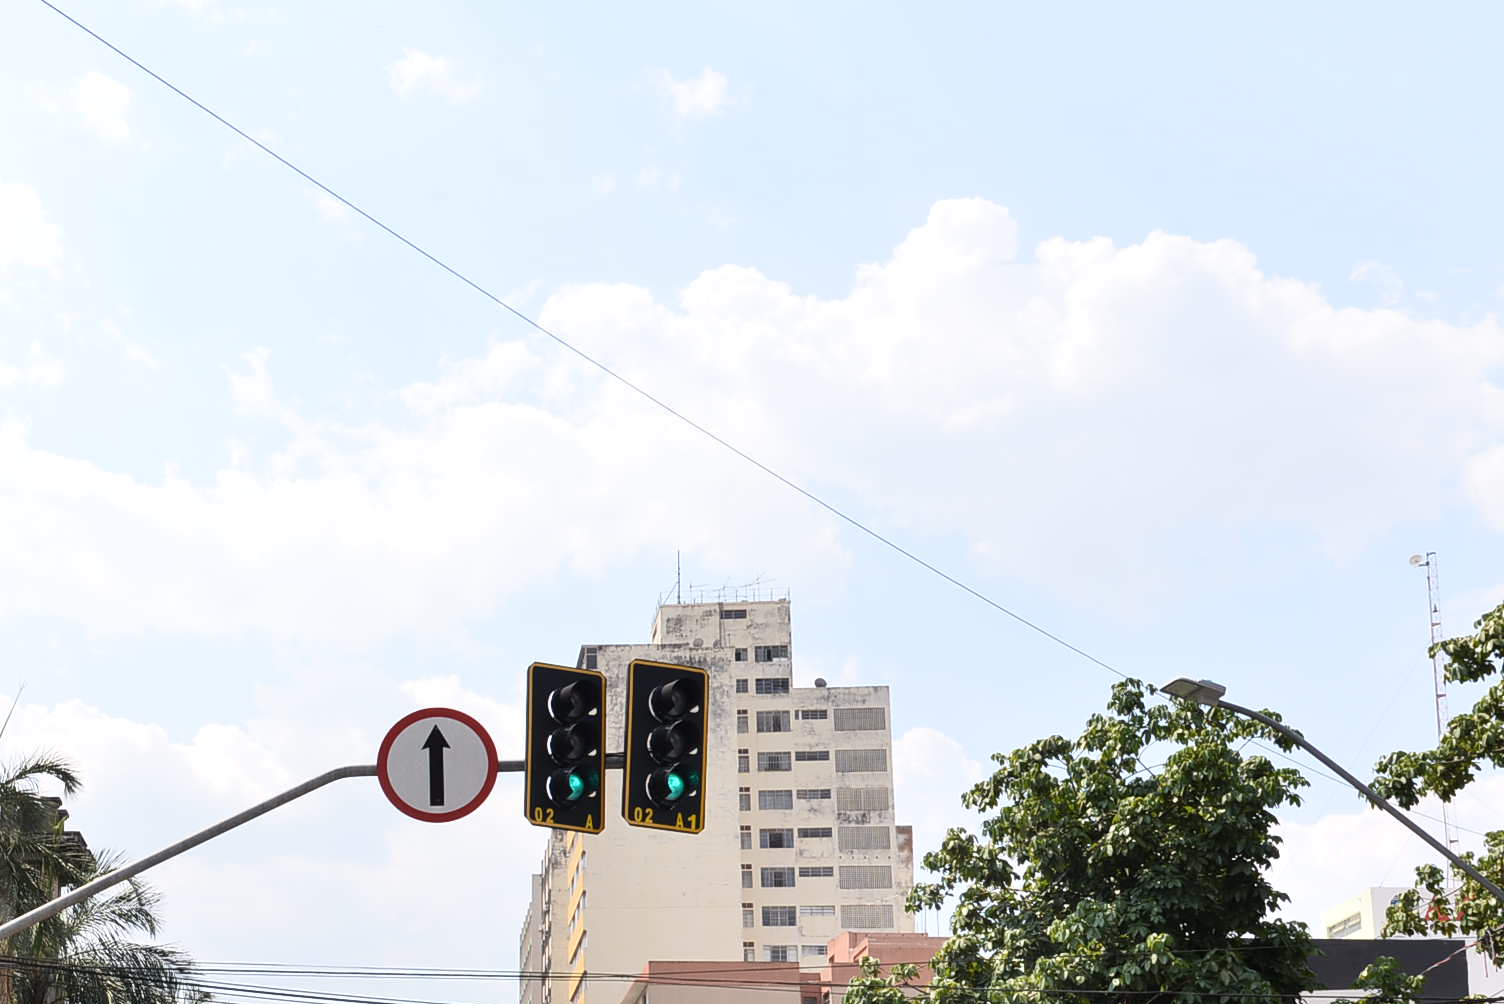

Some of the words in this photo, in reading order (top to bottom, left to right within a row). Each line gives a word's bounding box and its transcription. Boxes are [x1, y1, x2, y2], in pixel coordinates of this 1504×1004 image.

[534, 807, 554, 824] 02
[586, 814, 593, 829] A
[634, 807, 654, 824] 02
[676, 813, 696, 831] A1
